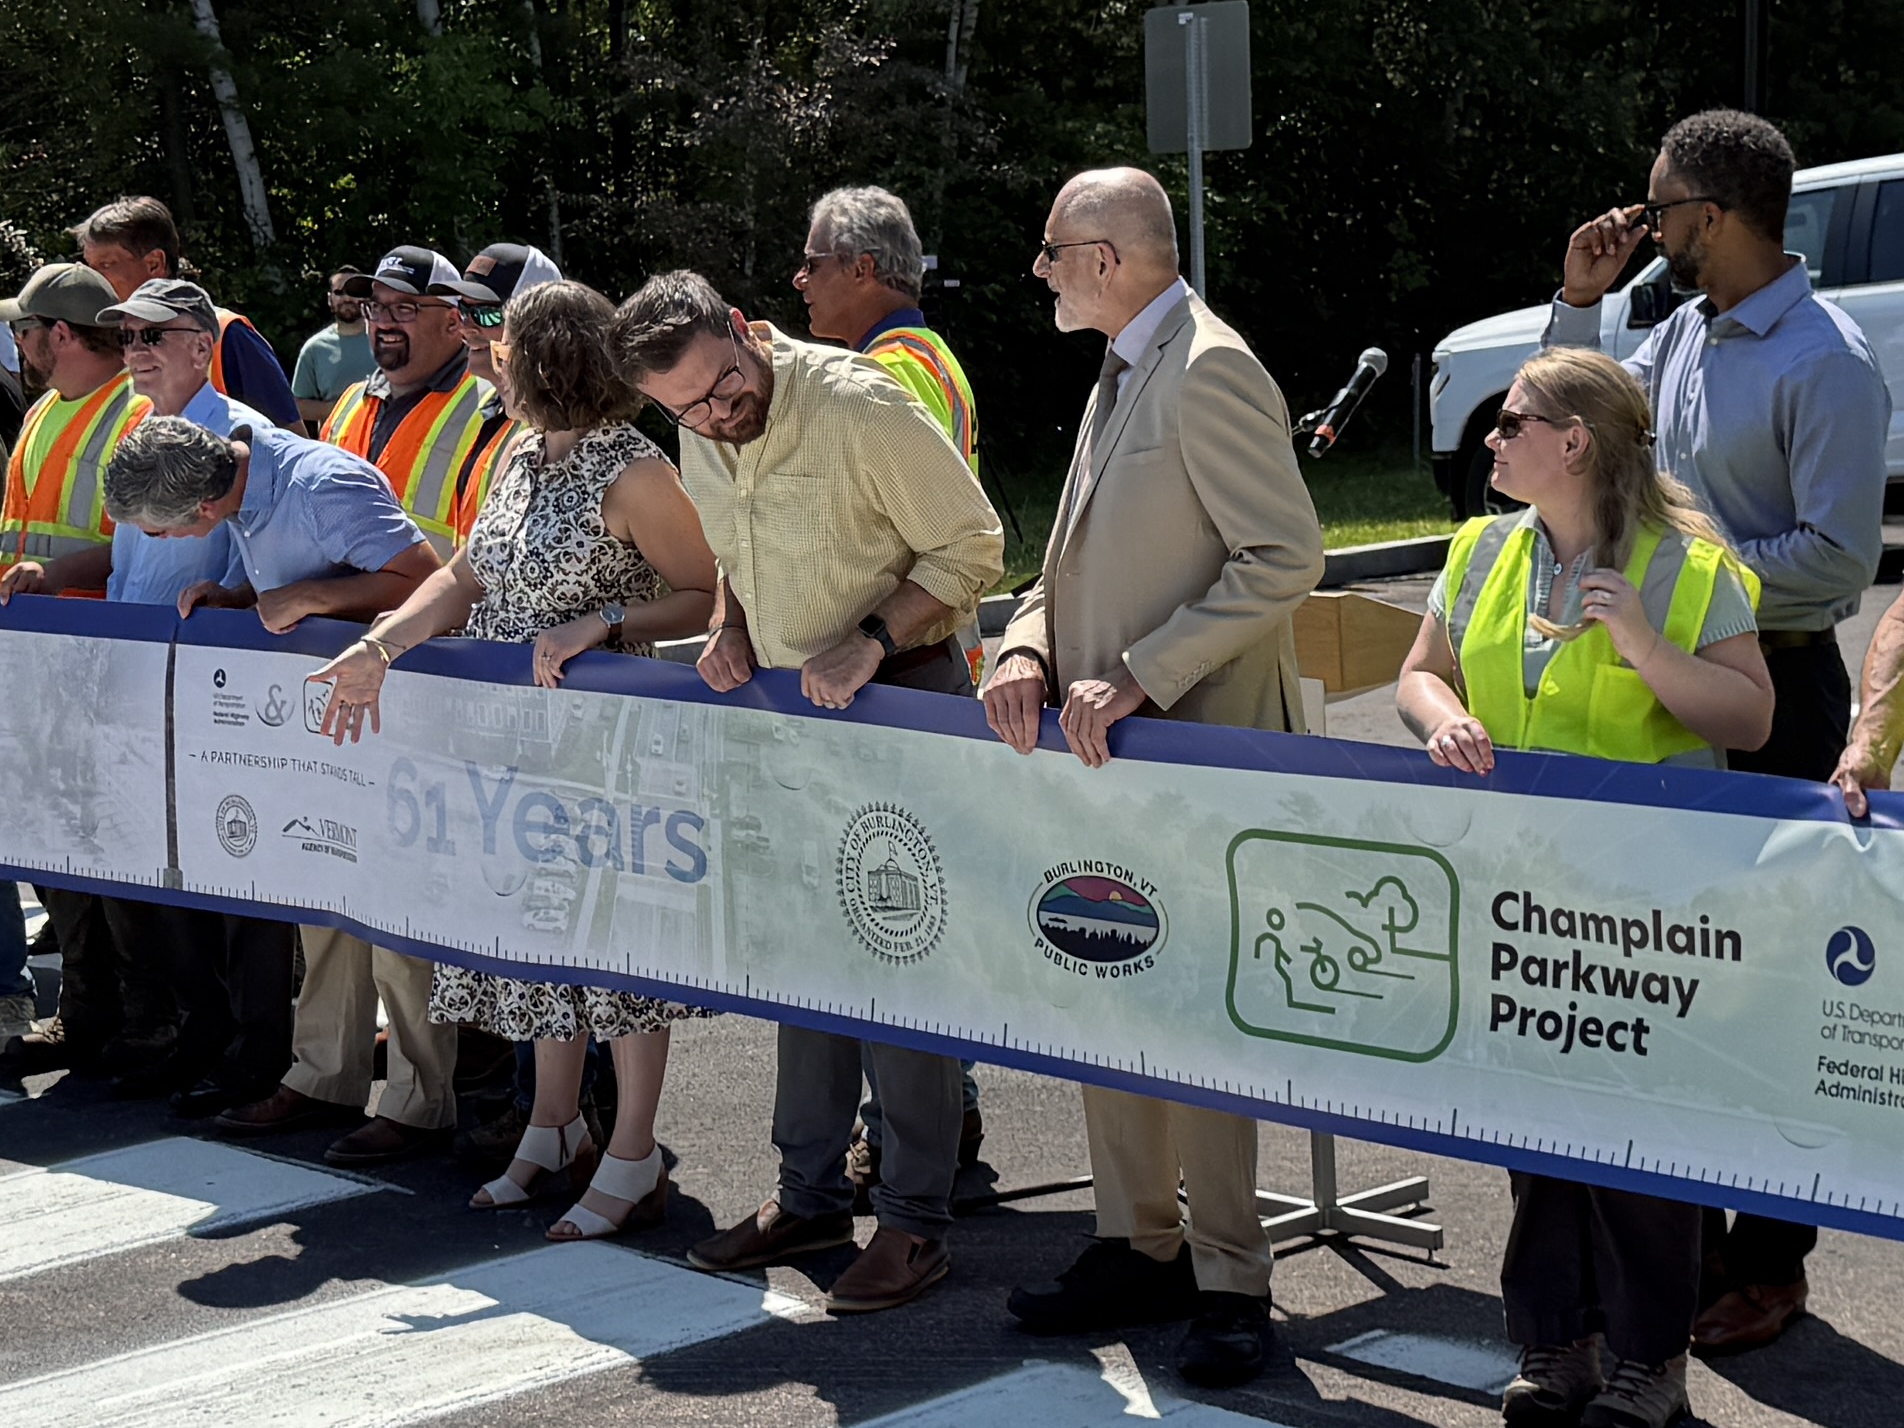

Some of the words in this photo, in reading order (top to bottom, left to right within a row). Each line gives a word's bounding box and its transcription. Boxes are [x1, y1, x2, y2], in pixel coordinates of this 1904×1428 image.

[264, 684, 287, 724] &
[201, 750, 209, 762] A
[210, 751, 288, 770] PARTNERSHIP
[290, 758, 318, 774] THAT
[386, 755, 456, 856] 61
[465, 759, 708, 884] Years
[850, 830, 862, 851] OF
[845, 856, 856, 893] CITY
[1491, 890, 1742, 962] Champlain
[1034, 938, 1088, 976] PUBLIC
[1095, 955, 1155, 979] WORKS
[1491, 941, 1700, 1018] Parkway
[1489, 993, 1650, 1056] Project
[1820, 1024, 1837, 1040] of
[1817, 1055, 1884, 1082] Federal
